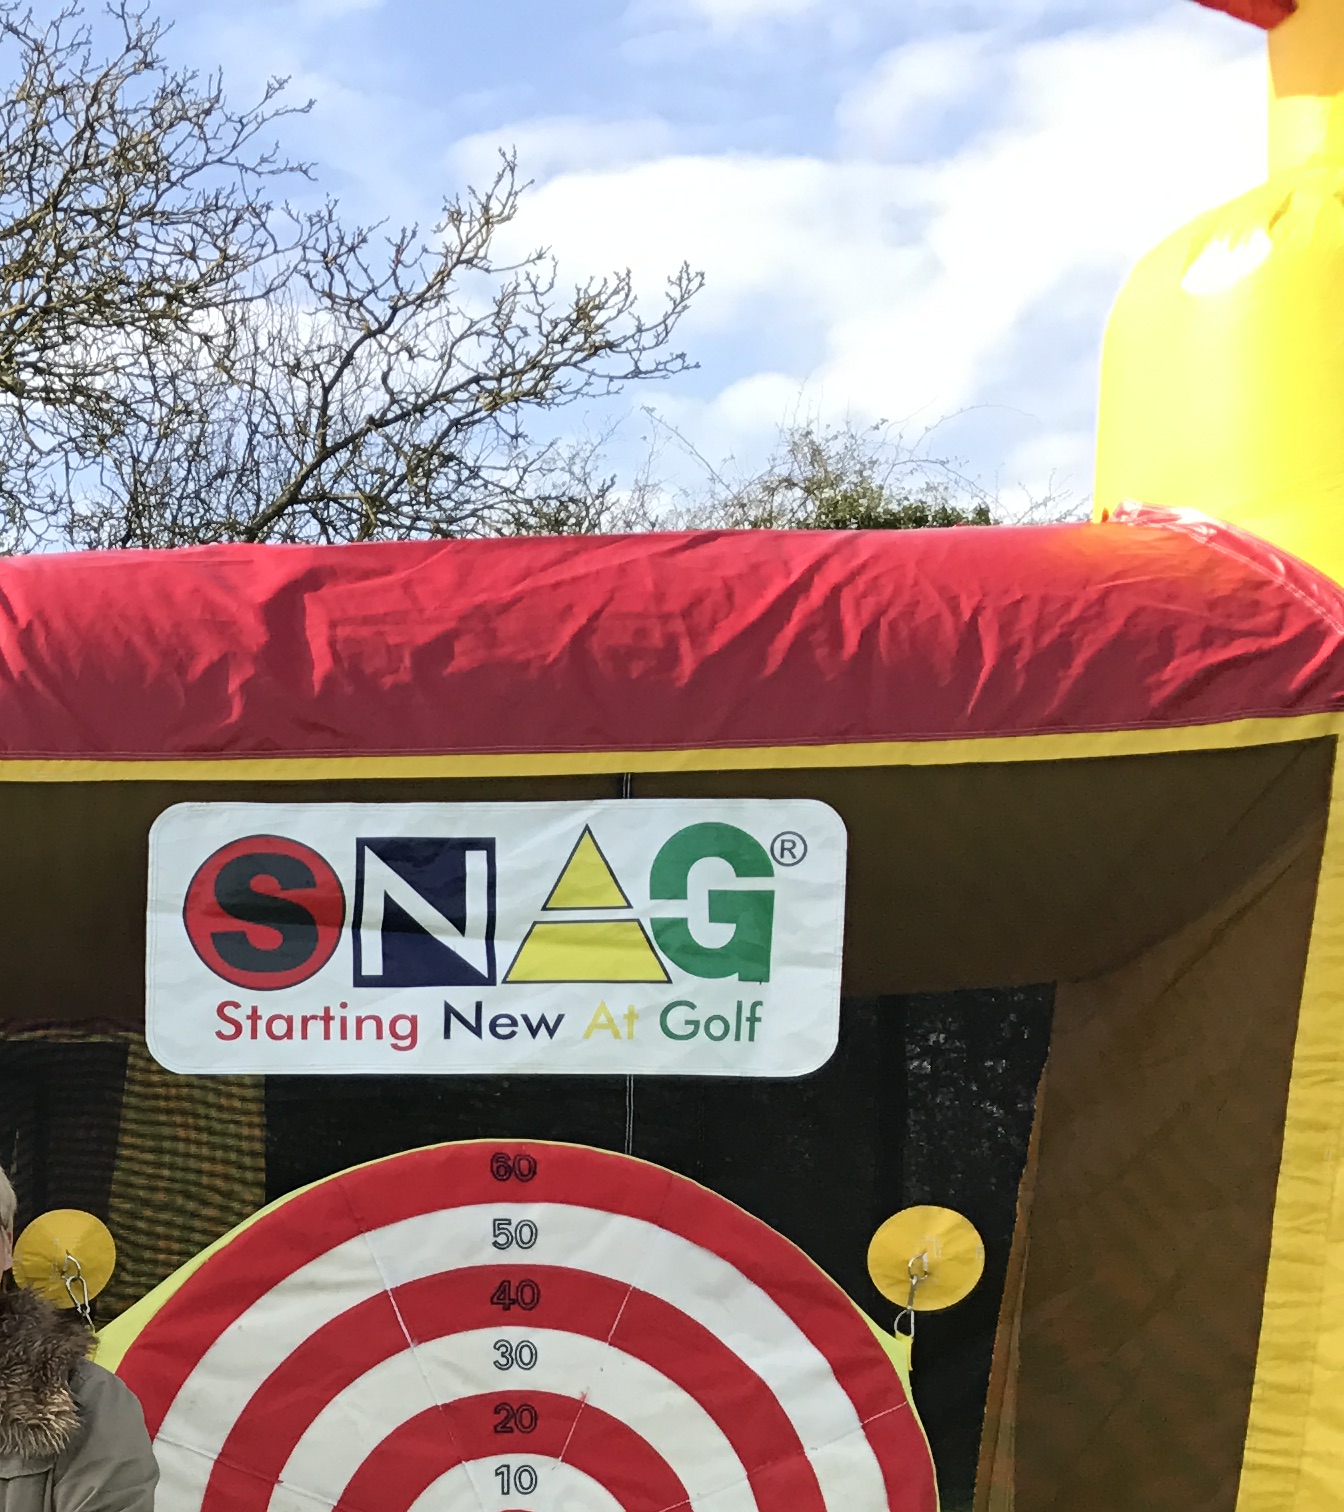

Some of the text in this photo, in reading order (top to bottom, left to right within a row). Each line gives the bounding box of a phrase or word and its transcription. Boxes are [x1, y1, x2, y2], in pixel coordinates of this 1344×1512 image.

[214, 1000, 763, 1051] Starting New At Golf
[490, 1153, 537, 1182] 60
[492, 1218, 538, 1250] 50
[490, 1279, 541, 1311] 40
[493, 1339, 538, 1370] 30
[494, 1403, 539, 1434] 20
[495, 1464, 538, 1495] 10
